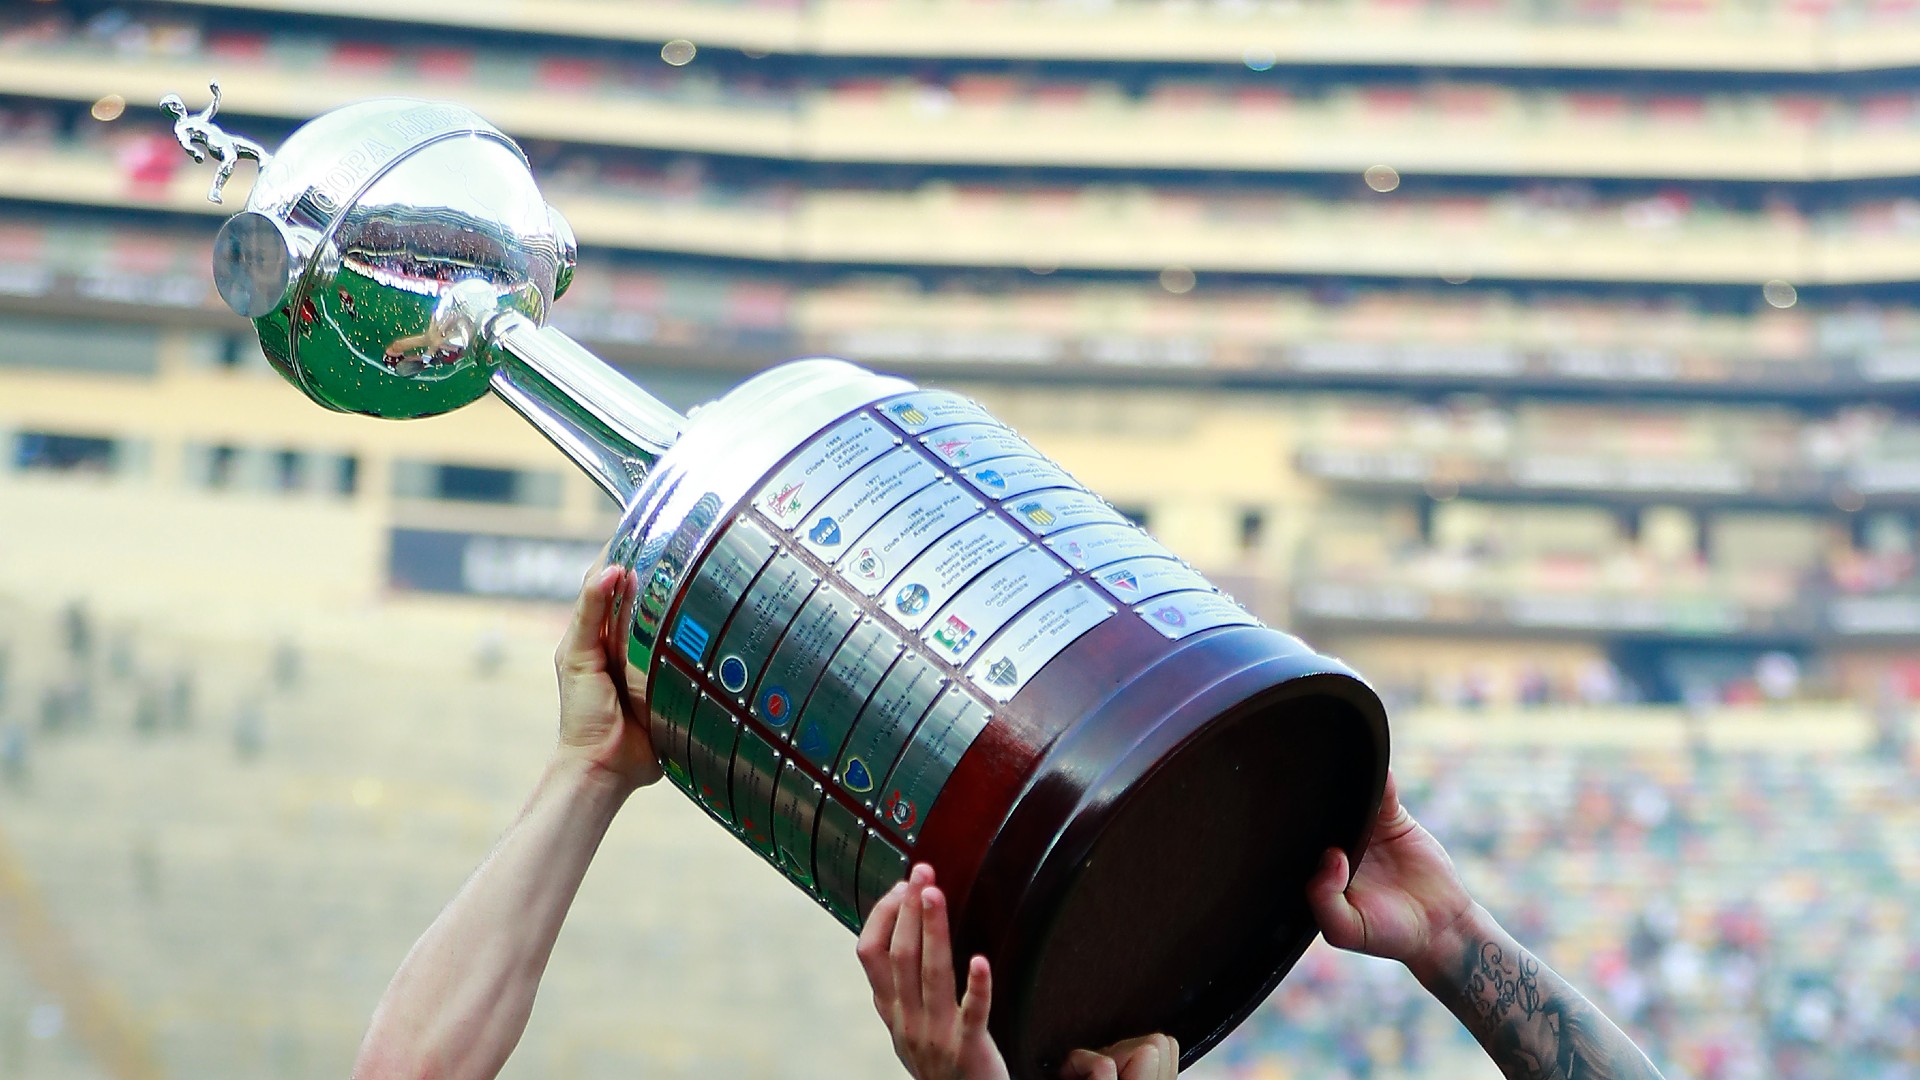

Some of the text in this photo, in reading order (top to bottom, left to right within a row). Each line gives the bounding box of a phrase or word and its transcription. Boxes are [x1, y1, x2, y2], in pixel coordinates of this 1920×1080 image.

[309, 137, 397, 214] COPA
[835, 444, 870, 471] Argentina
[842, 441, 860, 457] Plata
[836, 505, 854, 524] Club
[878, 472, 898, 489] Boca
[896, 459, 923, 477] Juniors
[863, 474, 882, 490] 1977
[868, 478, 904, 506] Argentina
[817, 523, 836, 545] CABJ
[882, 535, 900, 553] Club
[924, 503, 944, 519] River
[942, 493, 961, 507] Plate
[911, 511, 946, 539] Argentina
[777, 568, 797, 592] Clube
[939, 559, 961, 578] Porto
[939, 570, 961, 590] Porto
[958, 553, 983, 574] Alegre
[903, 665, 927, 694] Juniors
